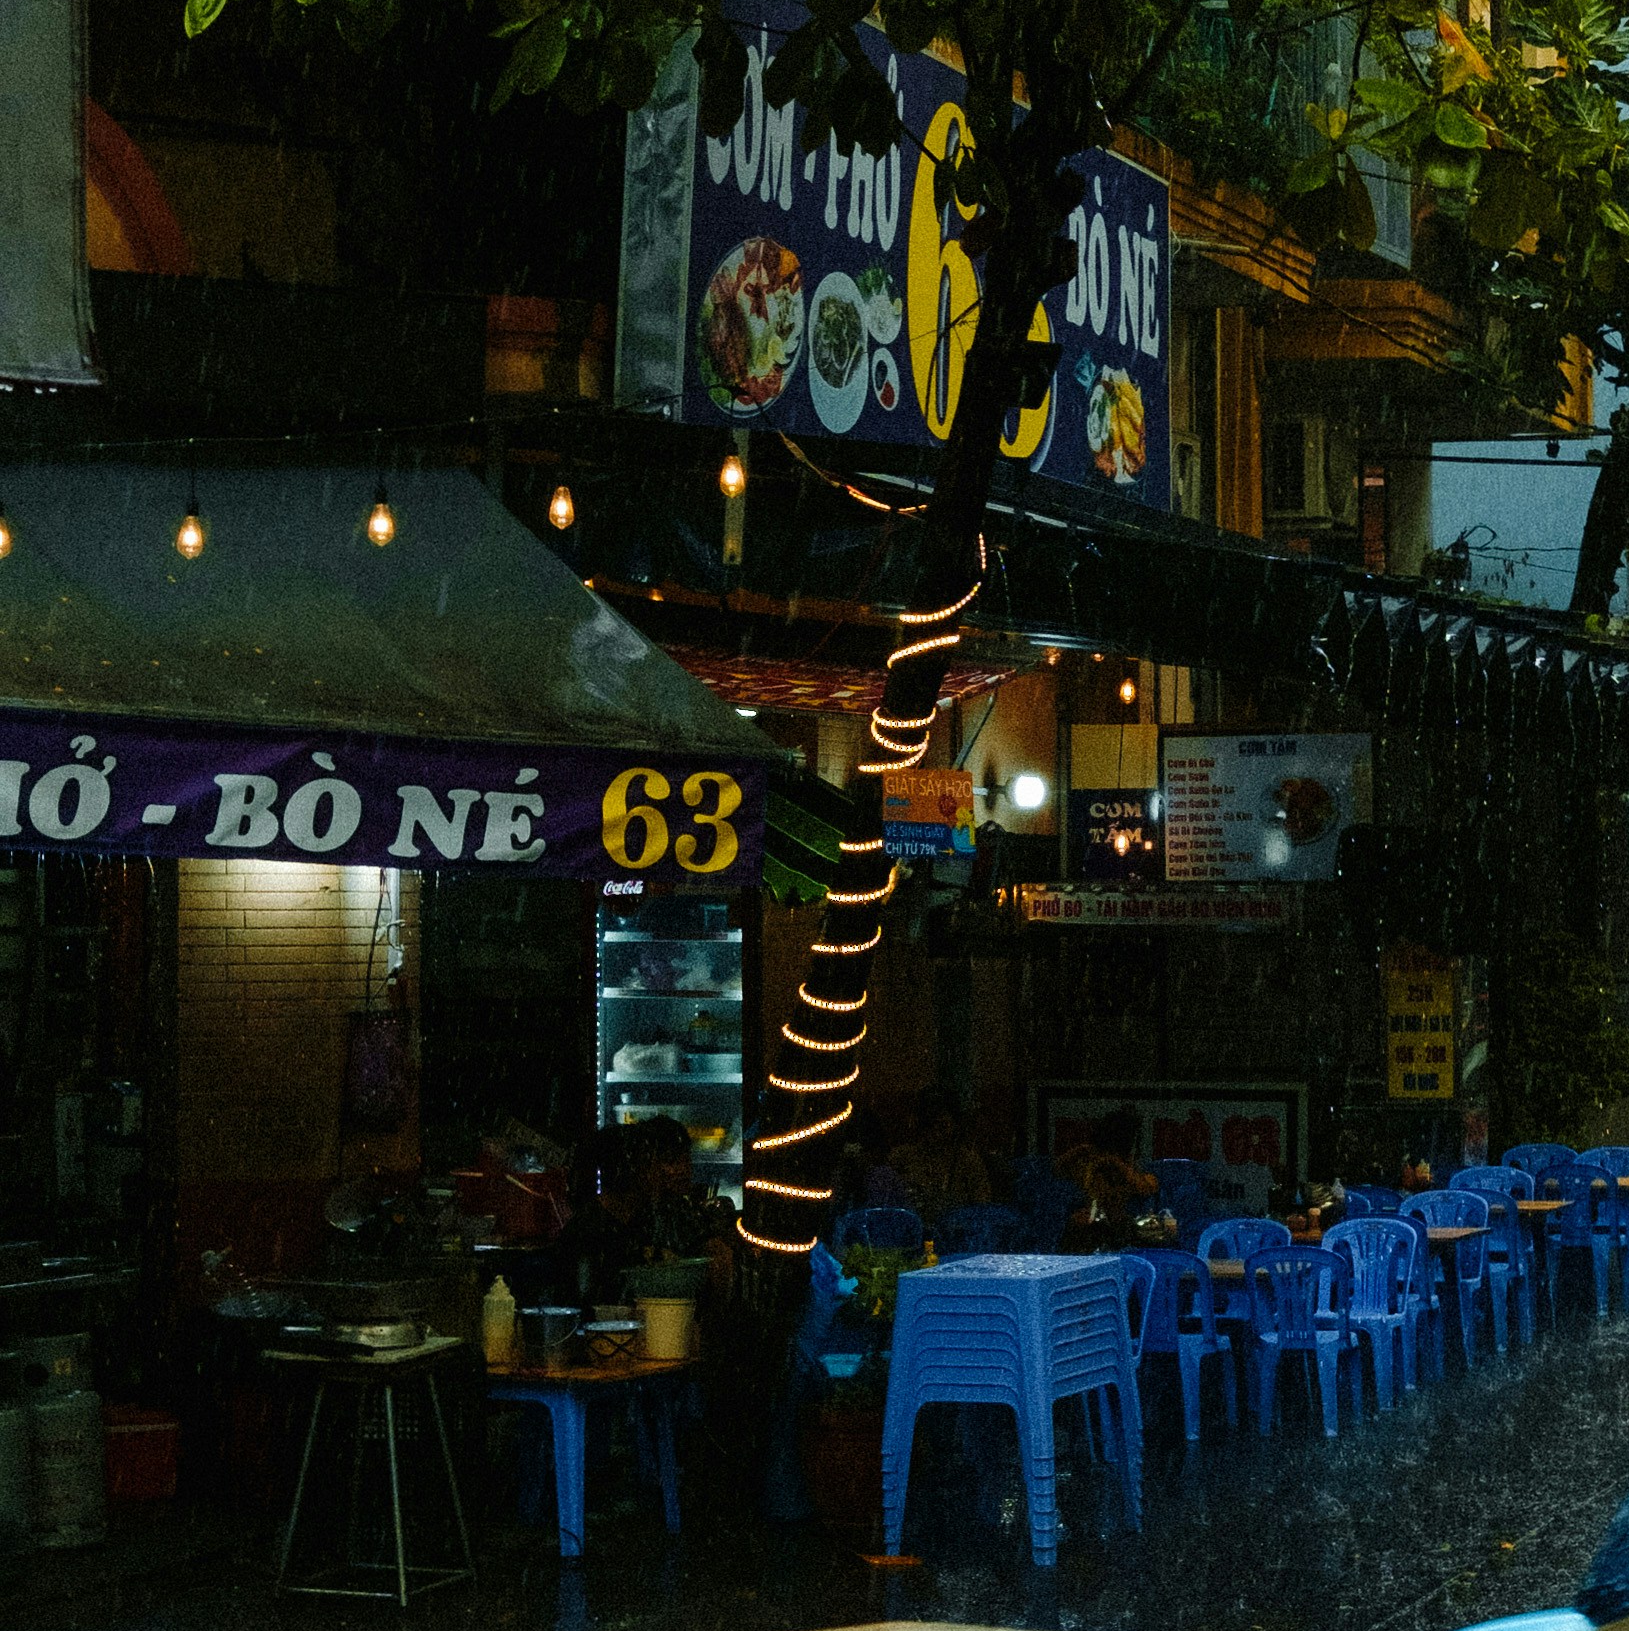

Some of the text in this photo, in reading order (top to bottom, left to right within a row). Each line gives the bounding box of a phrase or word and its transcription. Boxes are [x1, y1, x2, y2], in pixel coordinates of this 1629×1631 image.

[907, 101, 1053, 460] 6
[1117, 202, 1160, 359] NÉ
[945, 779, 972, 798] H2O
[204, 751, 363, 853] BÒ
[387, 768, 546, 863] NÉ
[601, 766, 744, 873] 63
[919, 843, 937, 856] 79K
[1032, 894, 1060, 917] PHỞ
